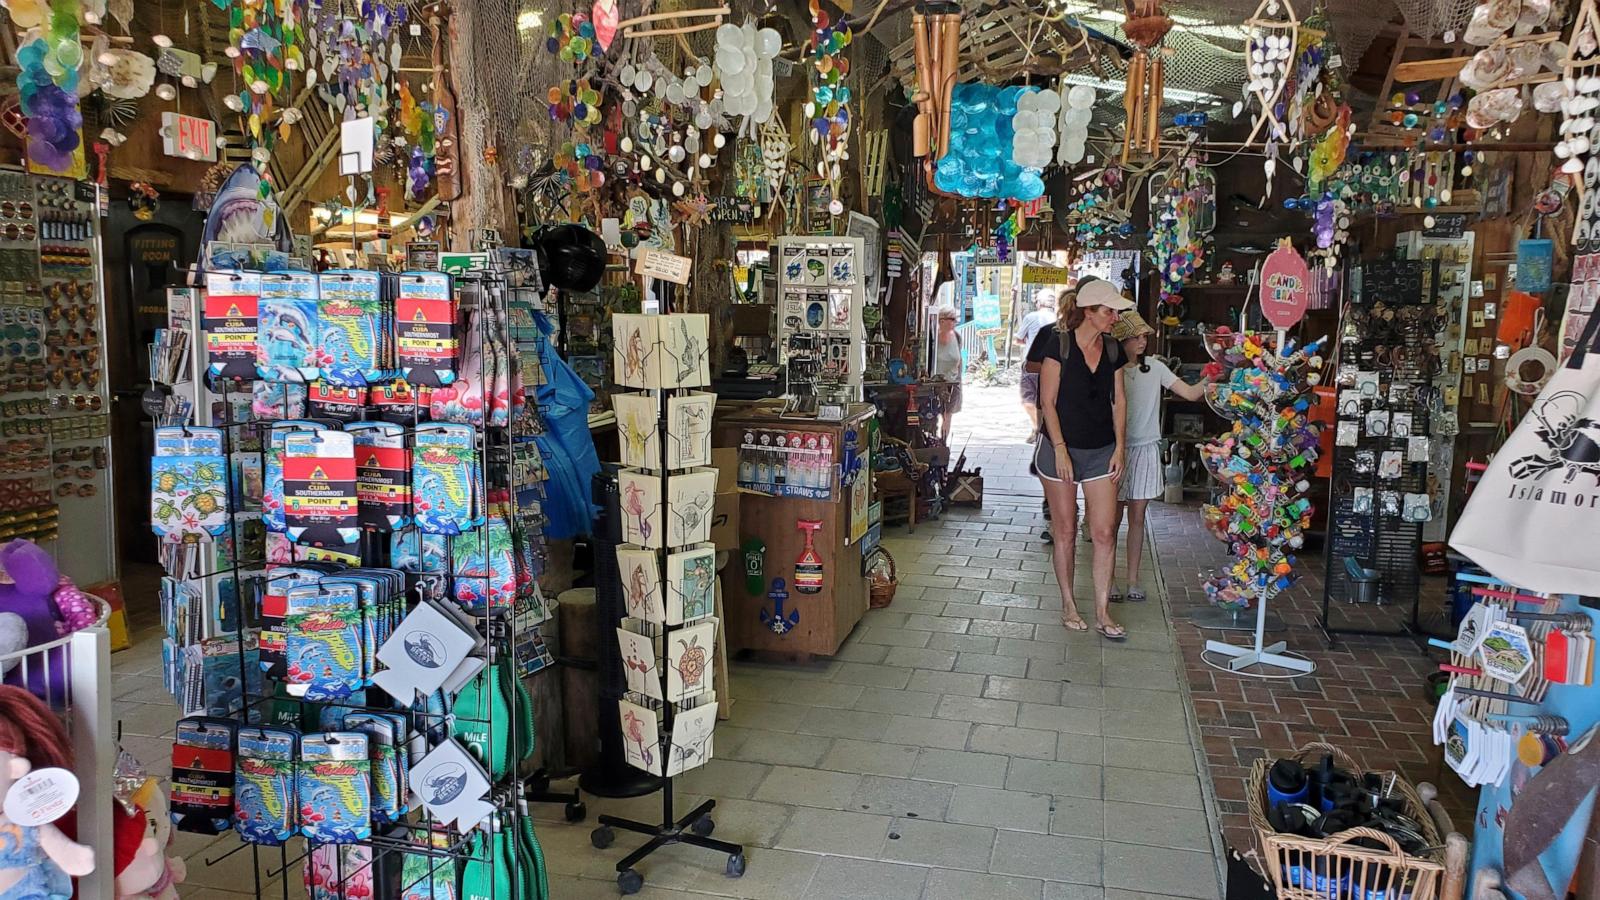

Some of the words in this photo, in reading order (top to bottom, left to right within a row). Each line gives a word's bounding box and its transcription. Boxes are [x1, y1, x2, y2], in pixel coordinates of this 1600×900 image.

[178, 116, 209, 157] EXIT
[132, 239, 176, 249] FITTING
[142, 251, 169, 260] ROOM
[357, 476, 394, 484] UTHERNMOST
[785, 485, 814, 498] STRAWS
[300, 620, 347, 635] Florida
[464, 732, 487, 743] MILE
